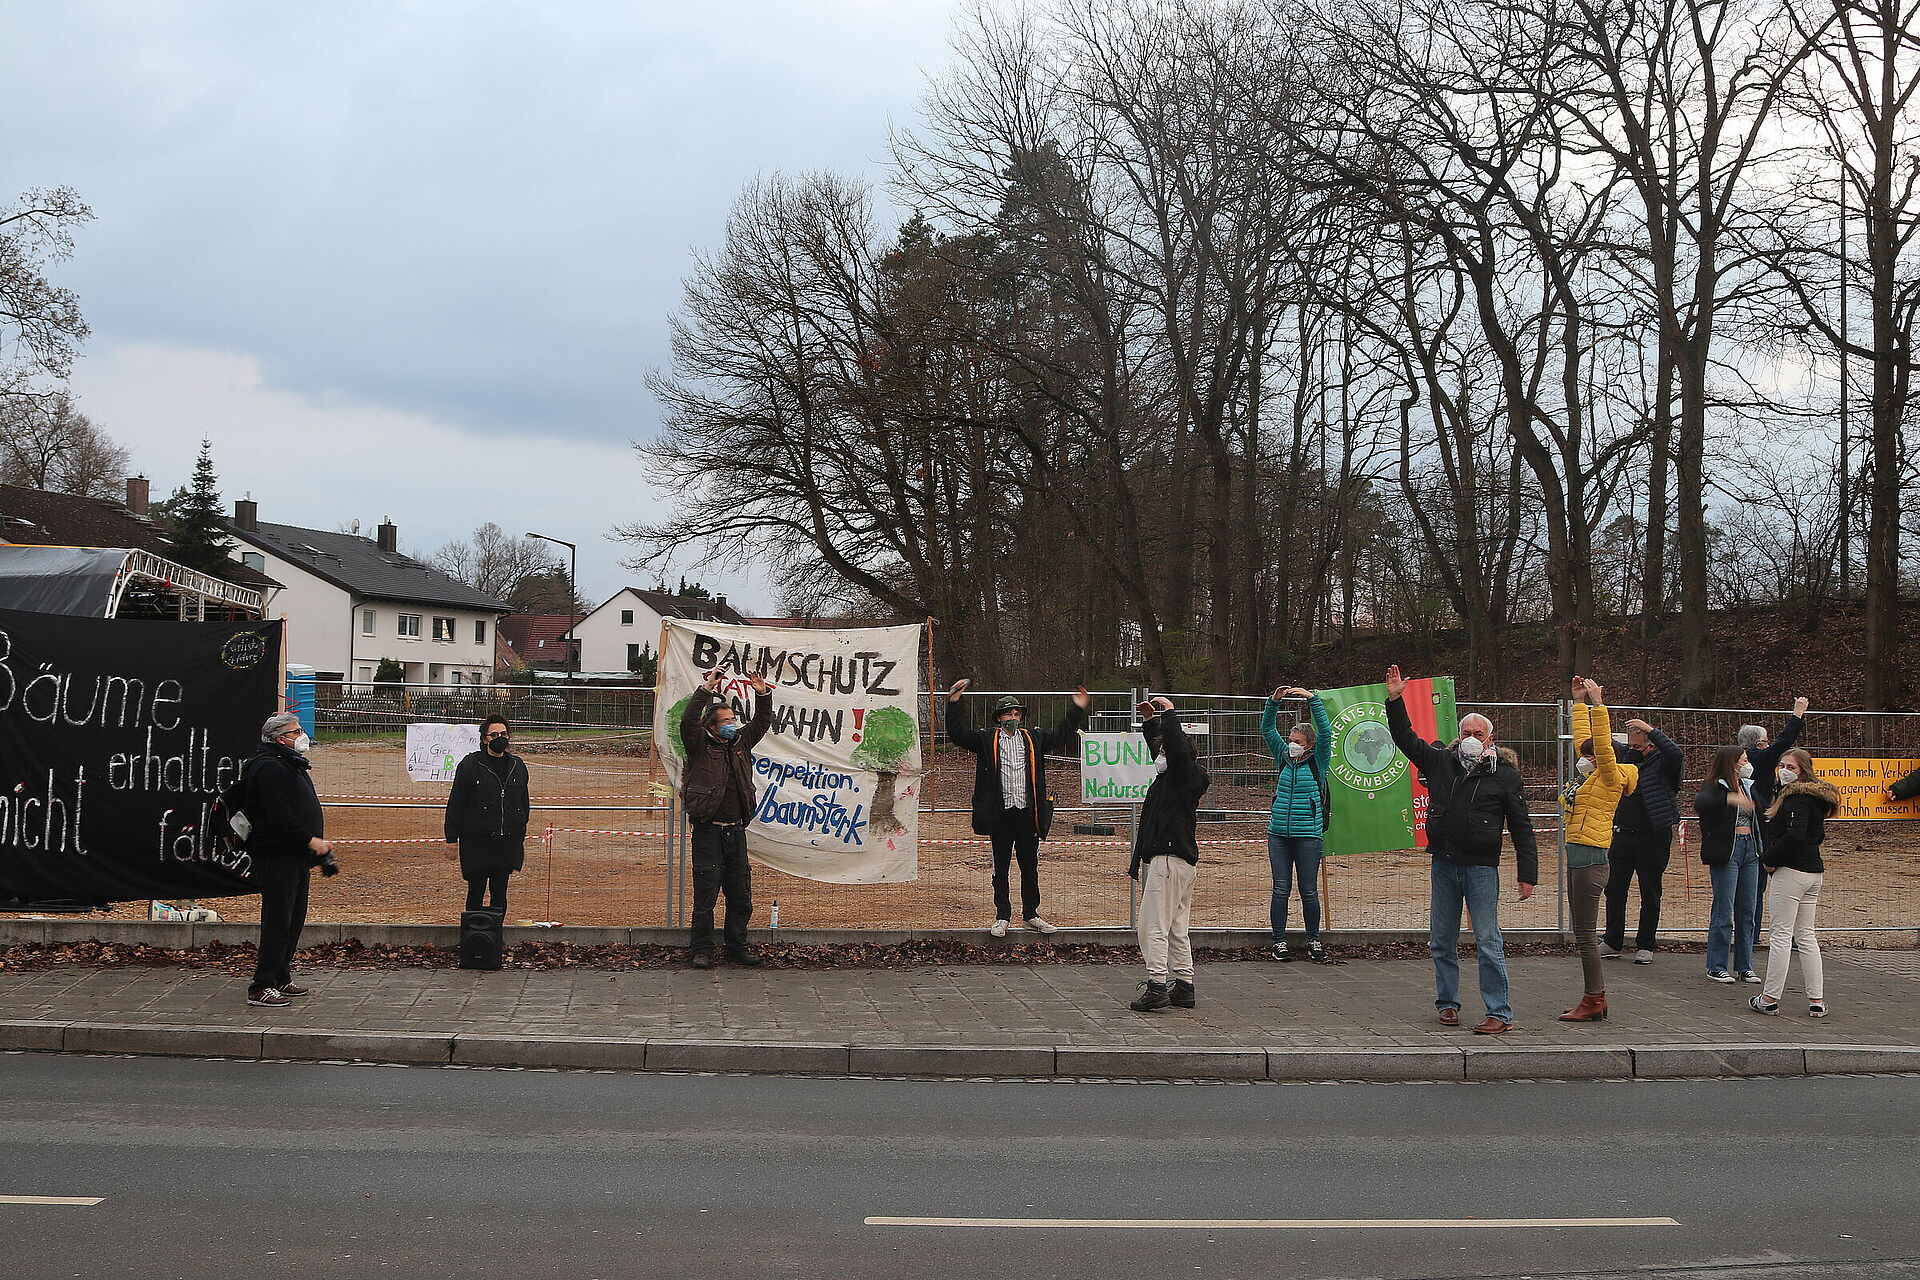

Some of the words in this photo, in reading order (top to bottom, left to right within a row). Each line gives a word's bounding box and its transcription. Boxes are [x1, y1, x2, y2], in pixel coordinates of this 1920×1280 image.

[692, 633, 900, 696] BAUMSCHUTZ
[408, 752, 441, 767] ALLE
[1829, 760, 1851, 778] noch
[1856, 761, 1877, 778] mehr
[1335, 760, 1405, 787] NÜRNBERG
[1085, 777, 1153, 798] Natursc
[1875, 801, 1909, 814] müssen
